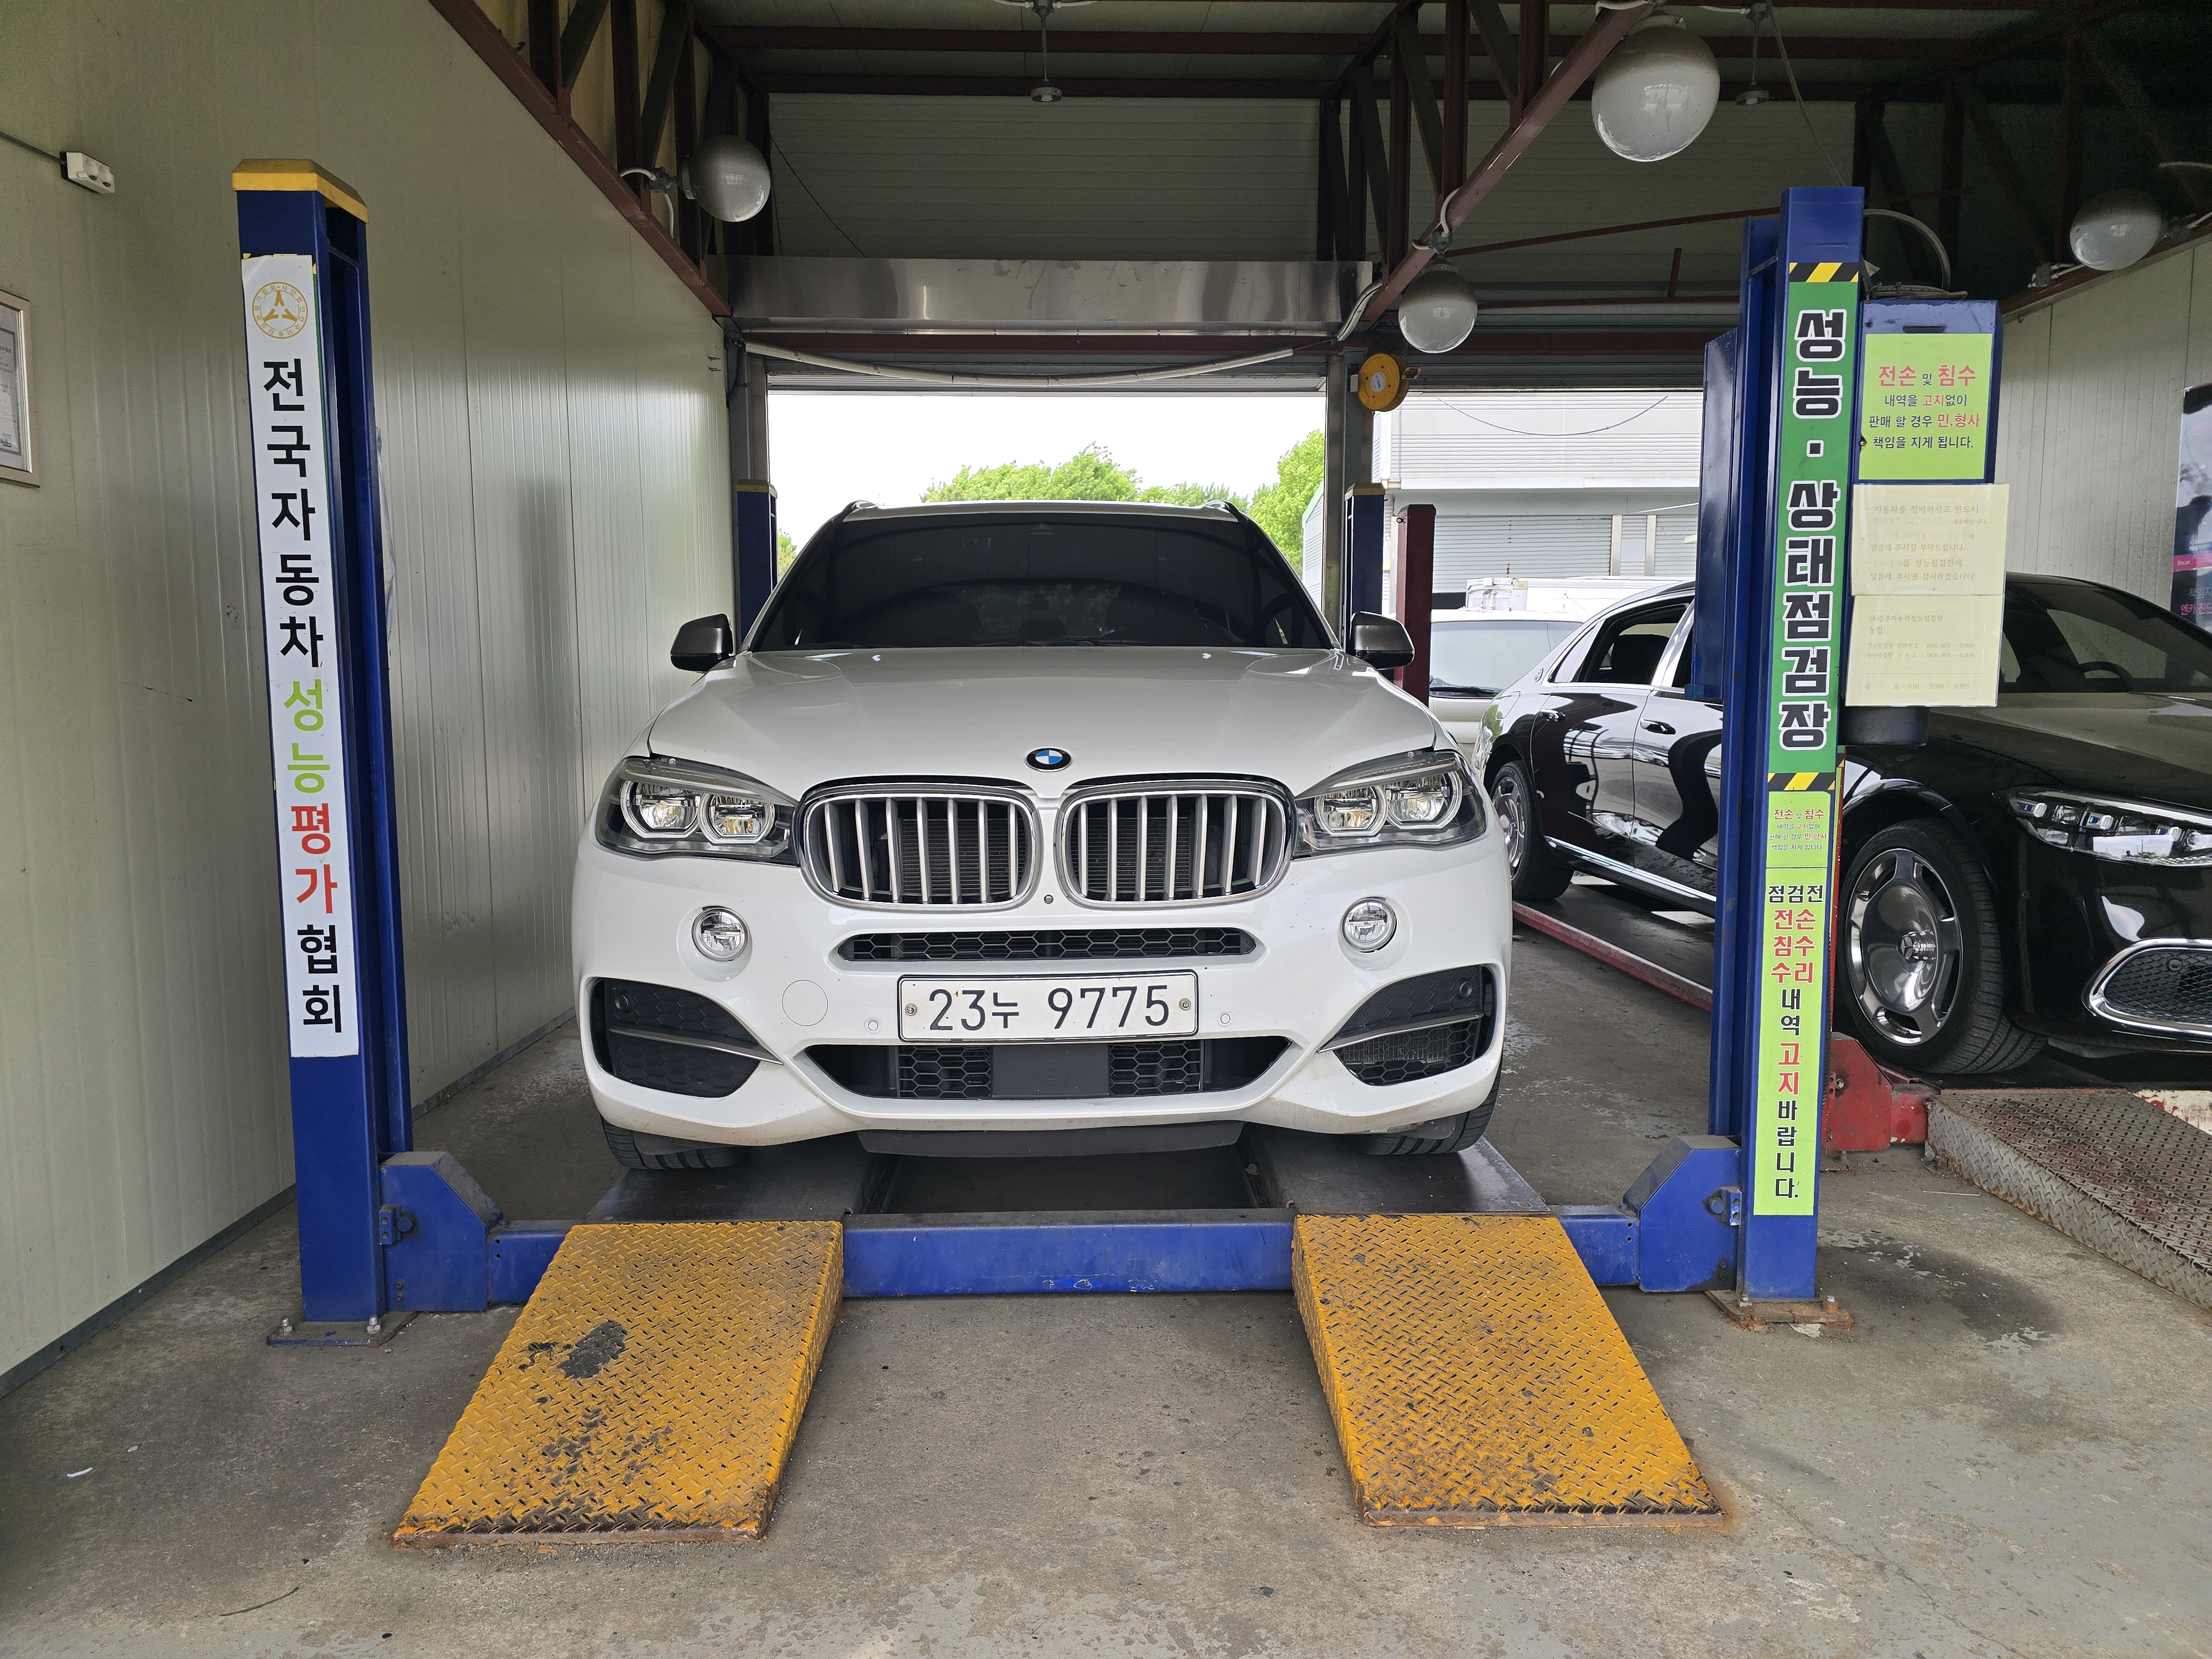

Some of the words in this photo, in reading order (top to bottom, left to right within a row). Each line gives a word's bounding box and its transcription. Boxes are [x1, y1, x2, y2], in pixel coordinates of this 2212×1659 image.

[1879, 365, 1916, 387] 전손
[1922, 373, 1932, 385] 및
[1938, 365, 1976, 387] 침수
[1885, 394, 1918, 407] 내역을
[1922, 394, 1967, 406] 고지없이
[1869, 416, 1891, 428] 판매
[1896, 416, 1906, 427] 할
[1911, 416, 1932, 427] 경우
[1938, 413, 1980, 428] 민,형사
[1873, 436, 1906, 448] 책임을
[1911, 436, 1933, 448] 지게
[1938, 436, 1974, 448] 됩니다.
[1955, 505, 1979, 514] 반드시
[1915, 559, 1962, 567] 성능점검전에
[1896, 572, 1918, 581] 주시면
[1774, 809, 1793, 819] 전손
[1805, 809, 1824, 819] 침수
[1768, 885, 1823, 902] 점검전
[1773, 909, 1815, 930] 전손
[1773, 936, 1814, 956] 침수
[1771, 962, 1813, 983] 수리
[929, 988, 1019, 1031] 23누
[1047, 984, 1169, 1029] 9775
